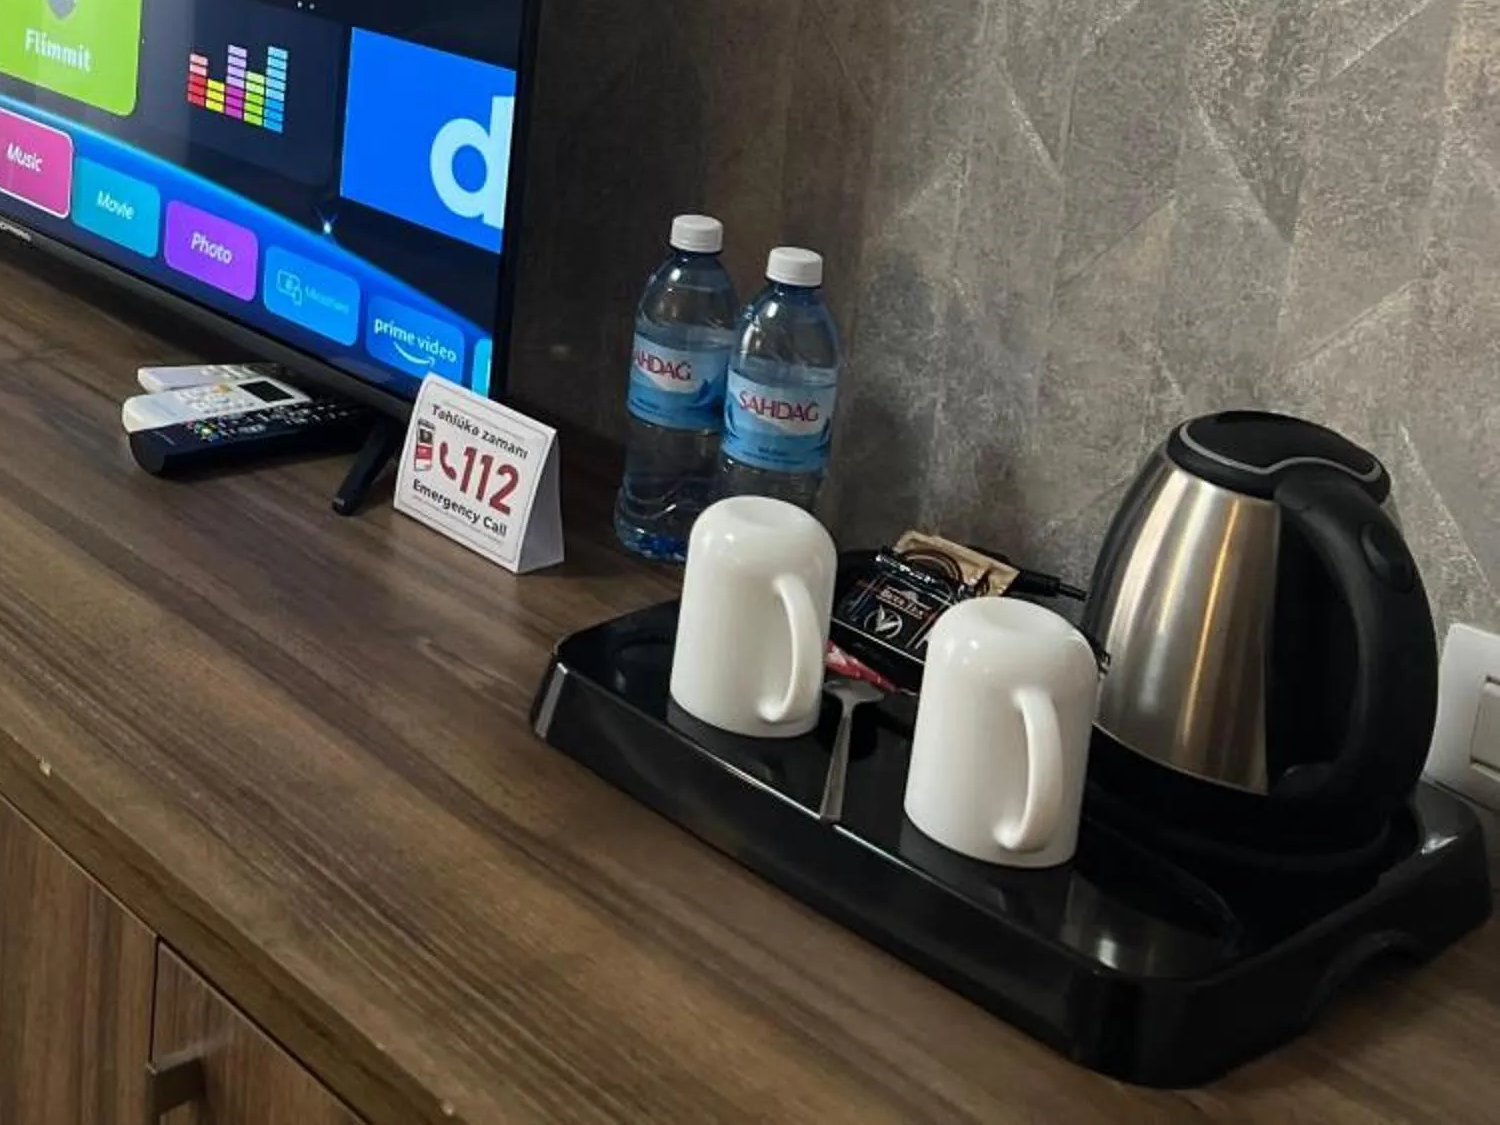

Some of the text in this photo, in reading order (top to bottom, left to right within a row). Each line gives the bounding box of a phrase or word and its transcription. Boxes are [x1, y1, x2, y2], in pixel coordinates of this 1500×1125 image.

[25, 27, 92, 73] Flimmit
[7, 142, 44, 173] Music
[96, 190, 136, 221] Movie
[190, 231, 233, 266] Photo
[374, 318, 457, 364] prime video
[459, 445, 520, 517] 112
[412, 477, 508, 538] Emergency Call
